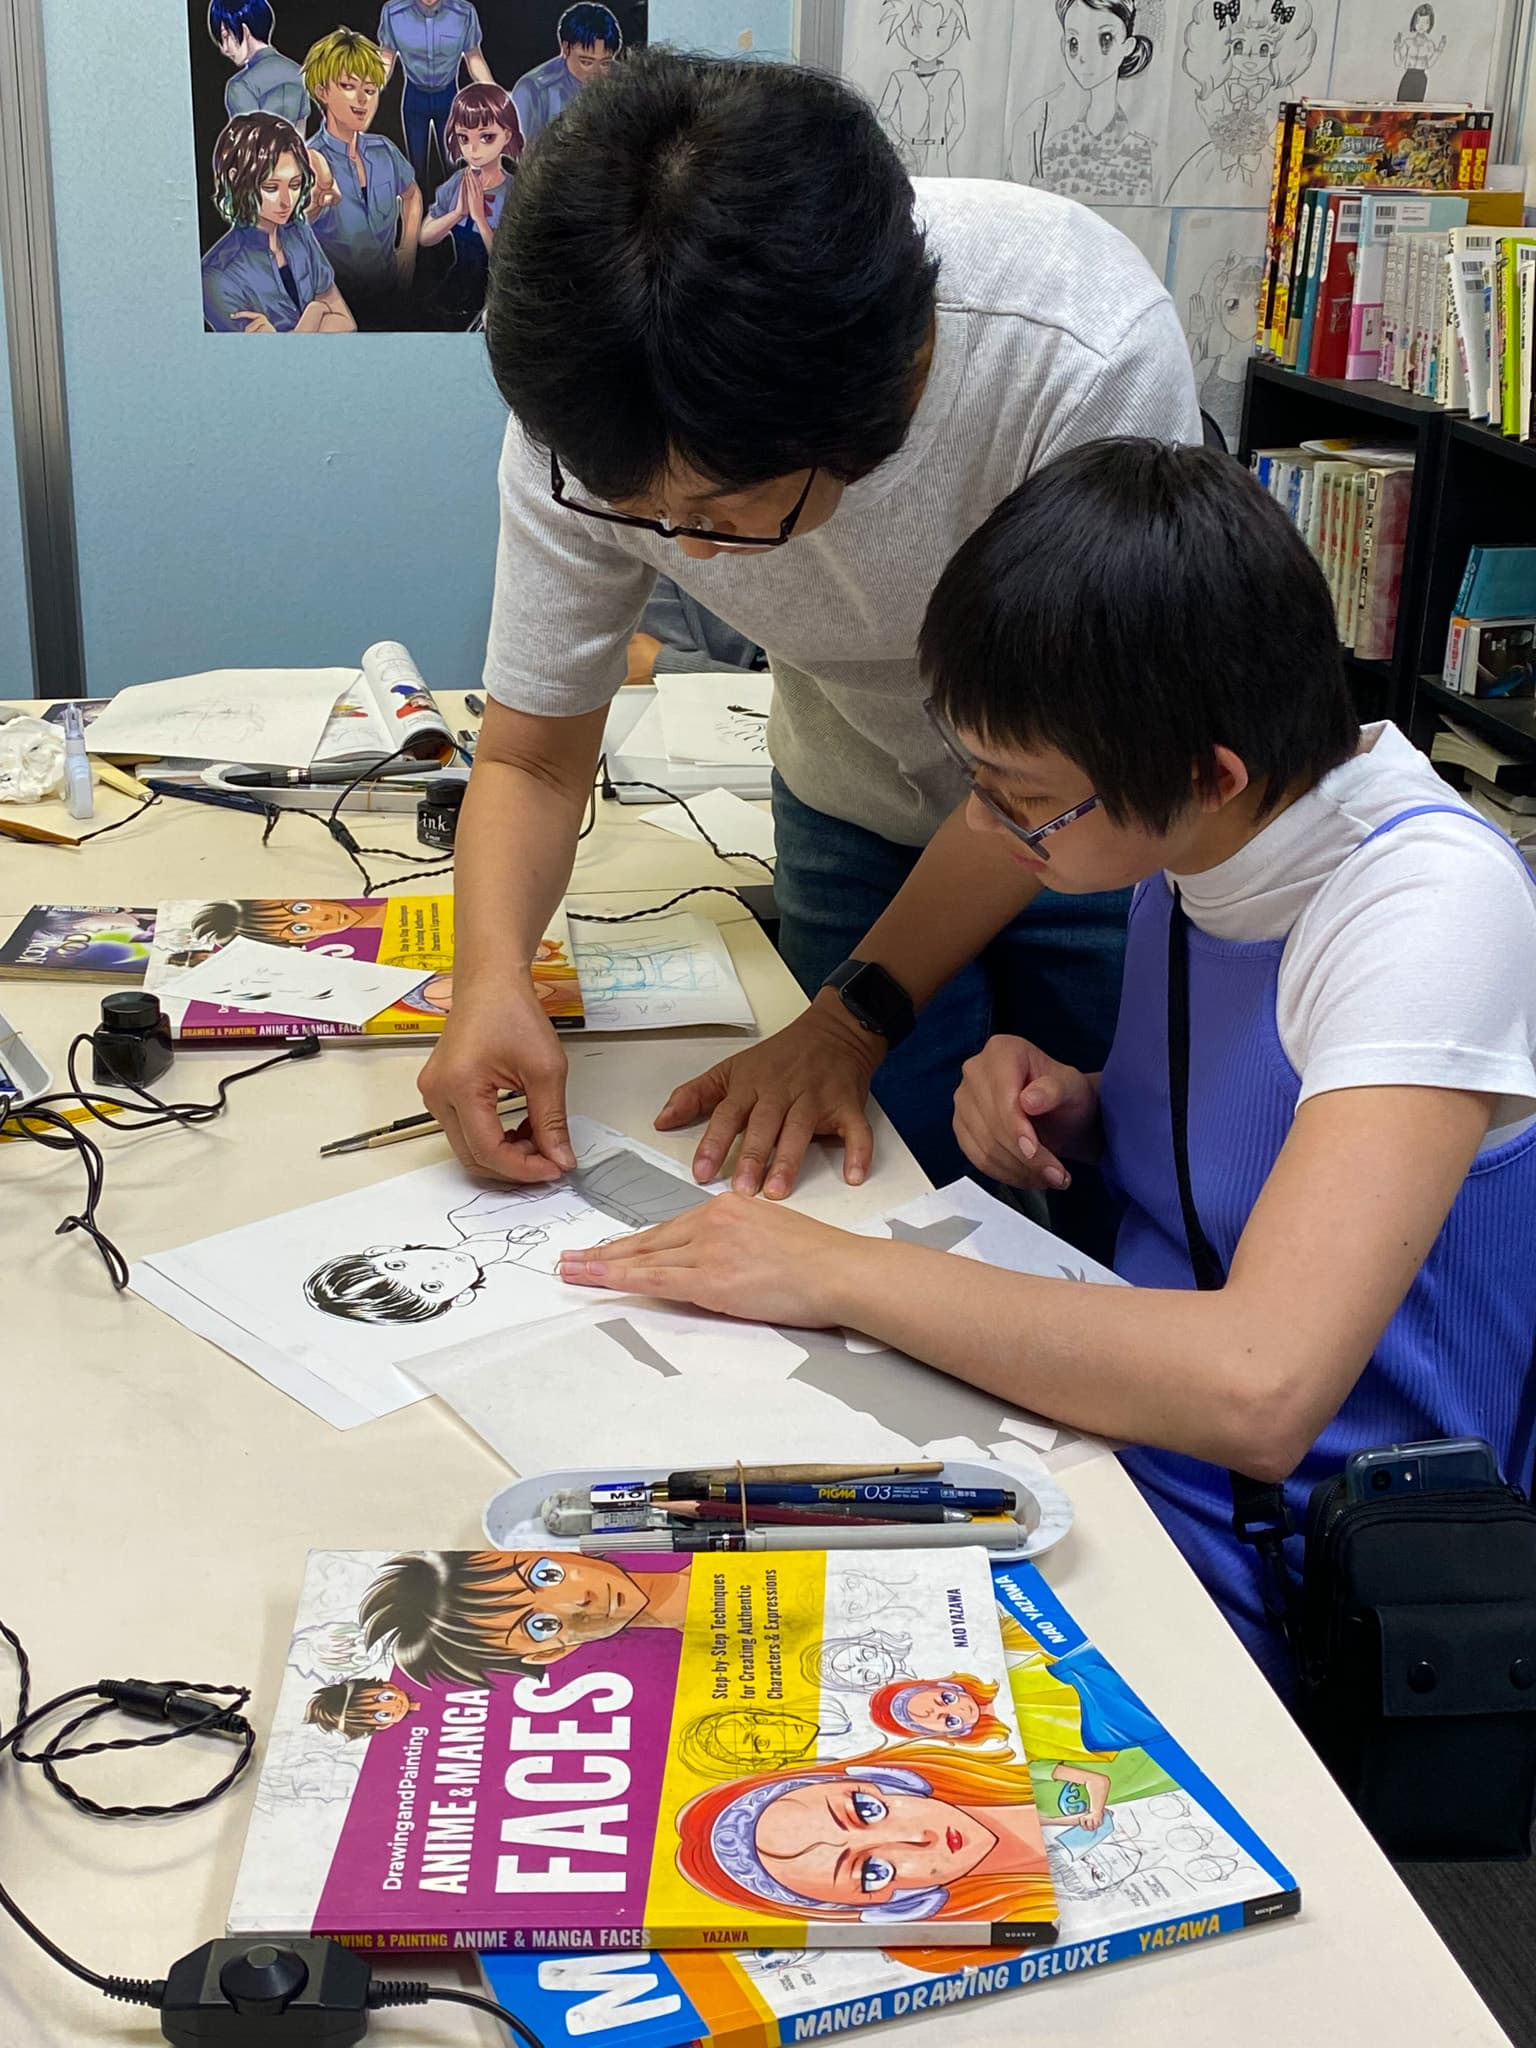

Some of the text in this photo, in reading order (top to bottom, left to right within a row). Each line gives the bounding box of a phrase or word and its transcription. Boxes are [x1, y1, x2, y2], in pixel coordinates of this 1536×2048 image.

[419, 812, 451, 832] ink
[259, 1025, 289, 1036] ANIME
[292, 1025, 299, 1035] &
[818, 1488, 857, 1500] PIGMA
[864, 1485, 891, 1501] 03
[710, 1573, 730, 1699] Step-by-Step Techniques
[737, 1584, 757, 1699] for Creating Authentic
[762, 1569, 783, 1700] Characters & Expressions
[946, 1588, 969, 1648] NAO YAZAWA
[994, 1574, 1068, 1645] NAO YAZAWA
[418, 1688, 490, 1895] ANIME & MANGA
[495, 1671, 634, 1894] FACES
[376, 1934, 385, 1947] &
[390, 1933, 448, 1948] PAINTING
[453, 1930, 508, 1948] ANIME
[514, 1930, 525, 1947] &
[532, 1929, 594, 1947] MANGA
[600, 1928, 651, 1947] FACES
[703, 1929, 749, 1944] YAZAWA
[1139, 1913, 1221, 1953] YAZAWA
[794, 1940, 1111, 2041] MANGA DRAWING DELUXE
